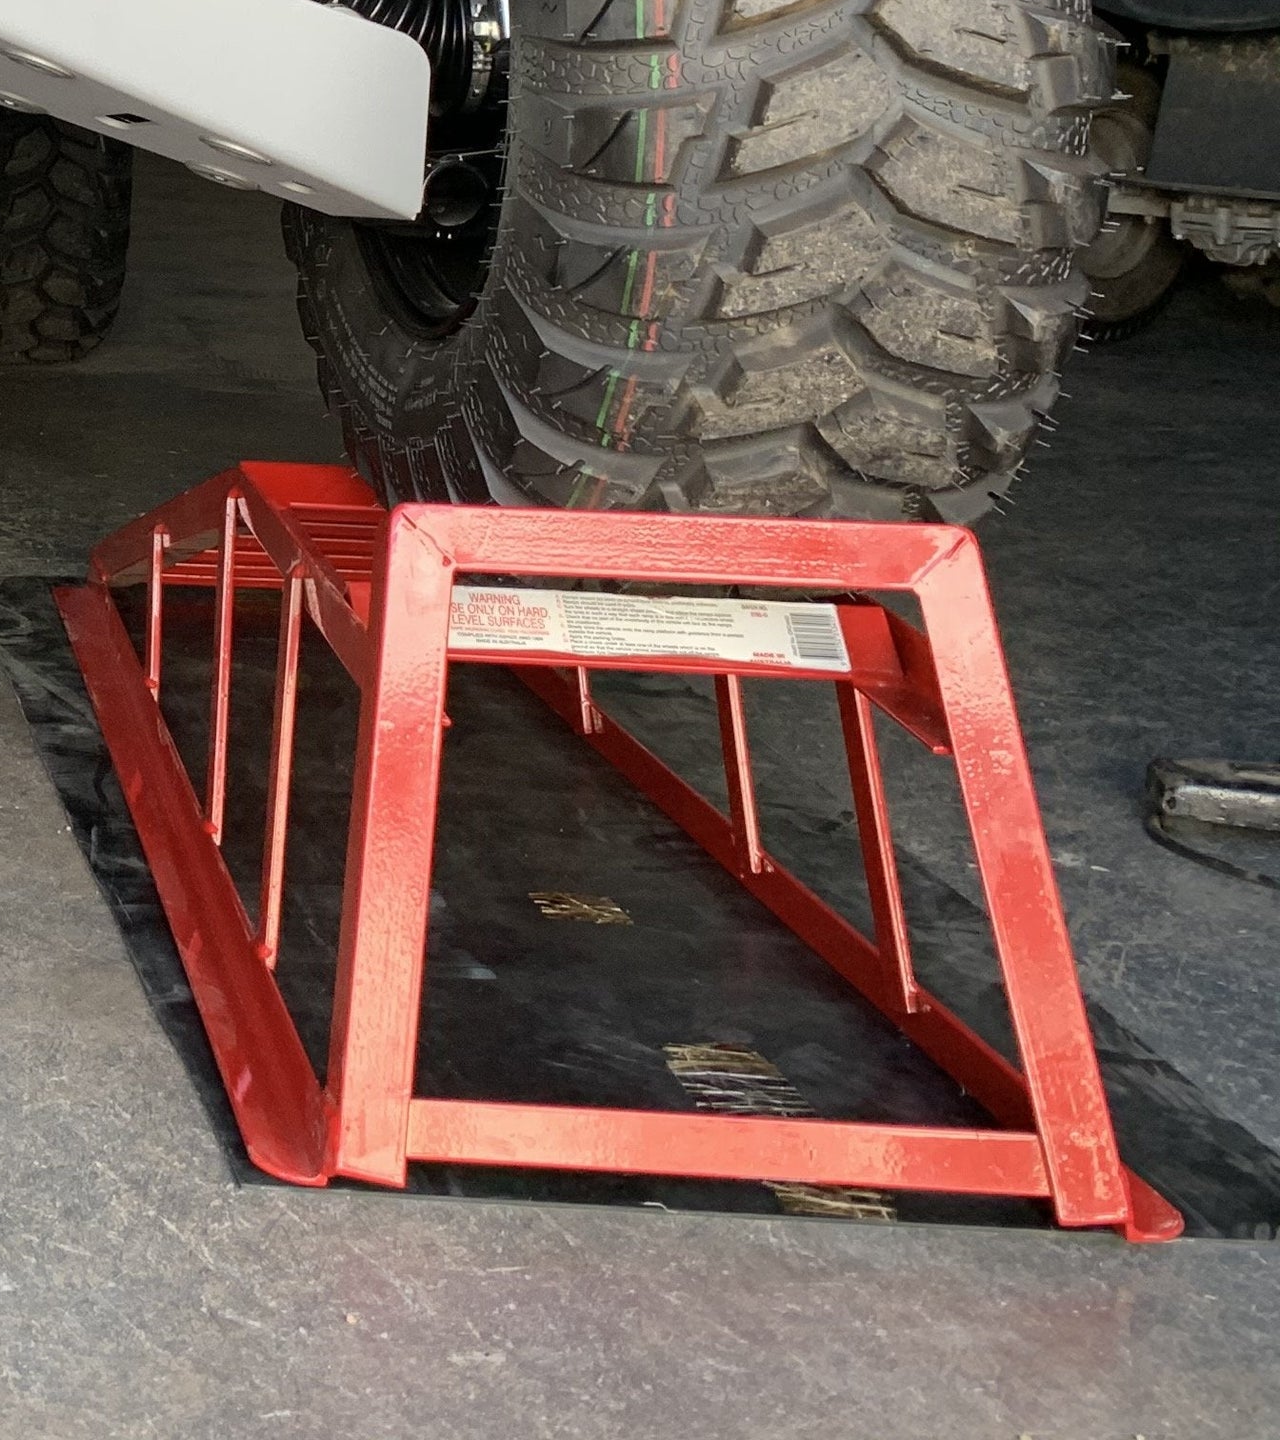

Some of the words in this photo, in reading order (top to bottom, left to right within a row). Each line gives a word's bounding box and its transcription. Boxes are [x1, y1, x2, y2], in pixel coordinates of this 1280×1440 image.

[468, 591, 521, 606] WARNING
[451, 602, 464, 614] SE
[467, 603, 495, 615] ONLY
[498, 605, 515, 616] ON
[452, 614, 485, 626] LEVEL
[487, 615, 546, 629] SURFACES
